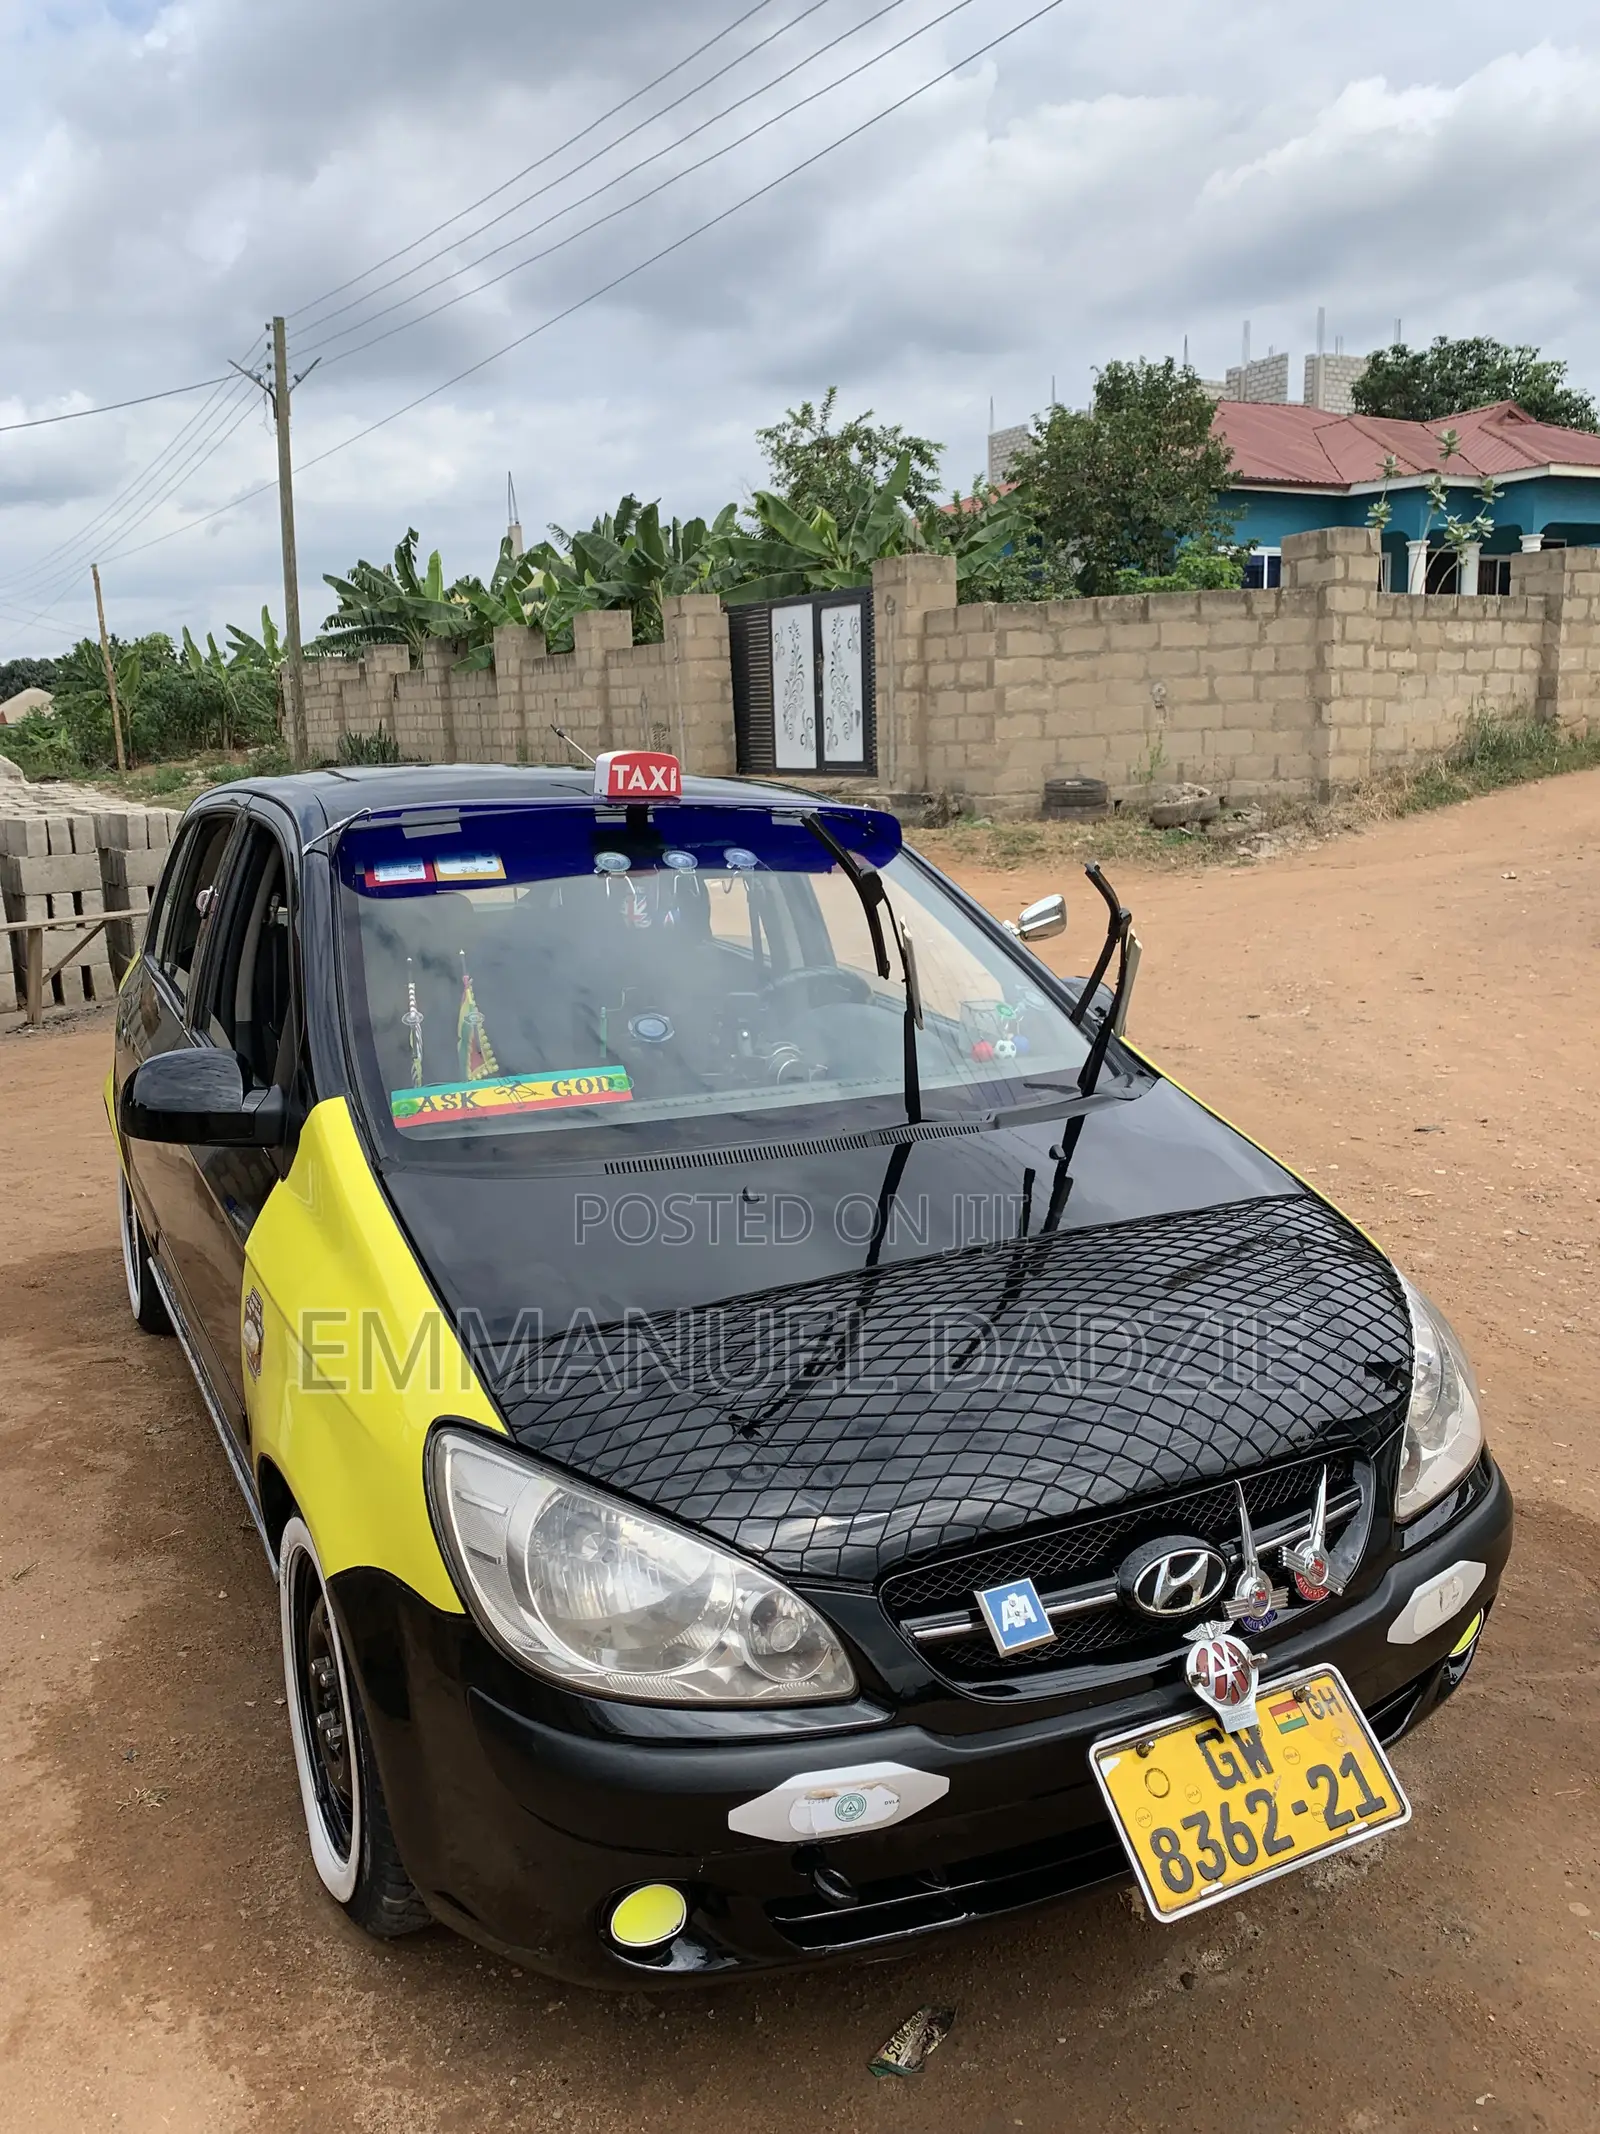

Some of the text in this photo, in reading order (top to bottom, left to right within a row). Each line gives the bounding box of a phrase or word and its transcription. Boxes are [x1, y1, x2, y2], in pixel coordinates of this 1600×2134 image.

[611, 764, 677, 792] TAXI
[417, 1075, 616, 1113] ASK GOD
[1297, 1576, 1327, 1601] MORRIS
[1244, 1612, 1274, 1632] MORRIS
[1305, 1686, 1343, 1720] GH
[1195, 1725, 1274, 1790] GW
[1150, 1751, 1387, 1894] 8362-21
